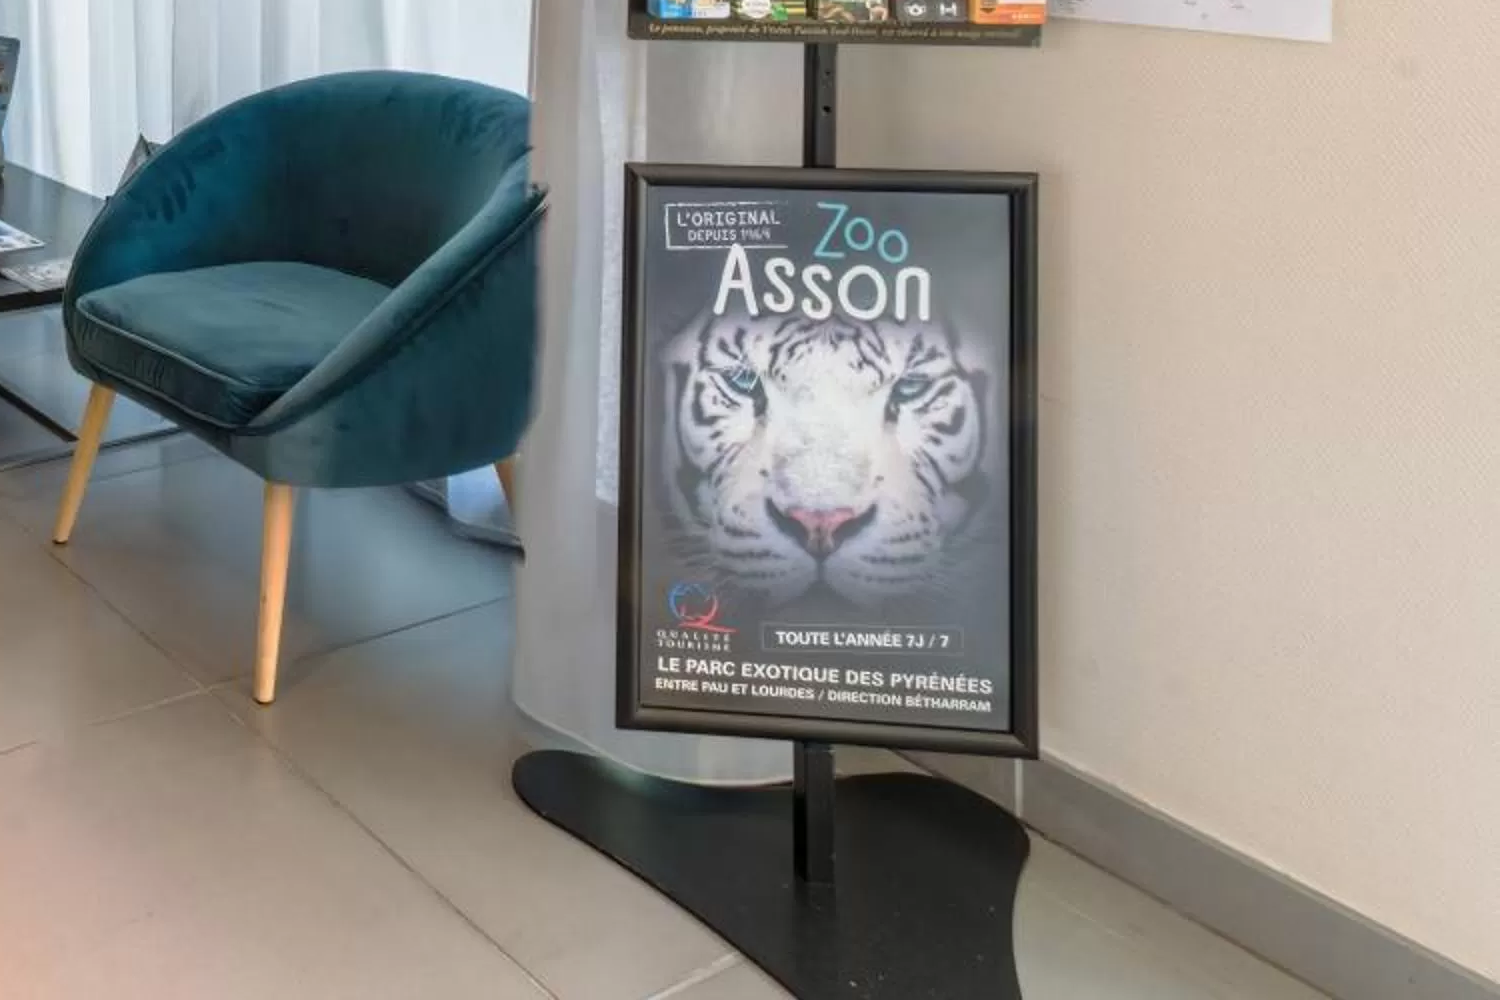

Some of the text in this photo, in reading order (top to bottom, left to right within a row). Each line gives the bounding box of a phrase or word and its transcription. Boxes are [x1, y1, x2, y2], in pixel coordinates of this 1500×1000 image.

[677, 209, 781, 227] L'ORIGINAL
[687, 228, 737, 242] DEPUIS
[814, 202, 910, 264] Zoo
[713, 243, 931, 322] Asson
[775, 630, 830, 646] TOUTE
[833, 629, 903, 648] L'ANNÉE
[906, 633, 925, 649] 7J
[939, 633, 950, 649] 7
[657, 655, 993, 695] LE PARC EXOTIQUE DES PYRÉNÉES
[655, 676, 699, 692] ENTRE
[701, 680, 729, 694] PAU
[731, 682, 749, 696] ET
[750, 684, 815, 700] LOURDES
[827, 688, 902, 707] DIRECTION
[904, 692, 992, 713] BÉTHARRAM
